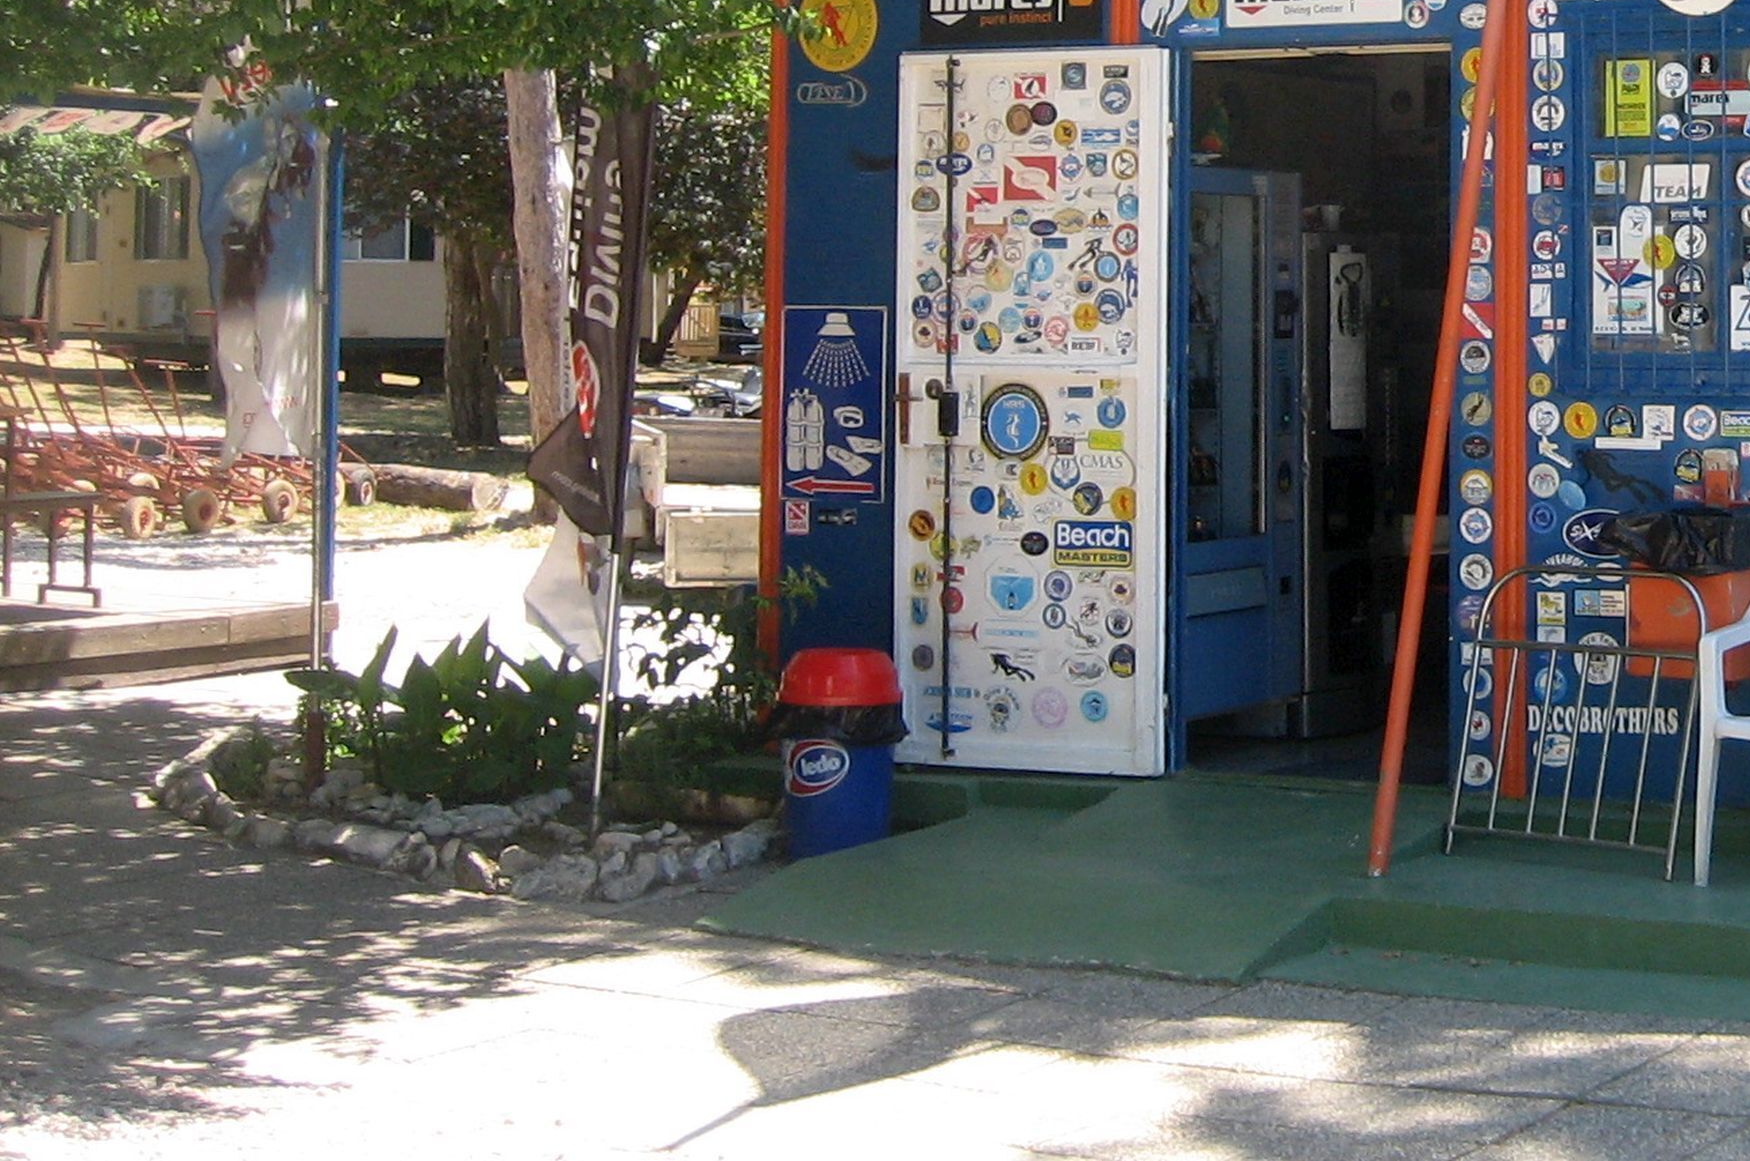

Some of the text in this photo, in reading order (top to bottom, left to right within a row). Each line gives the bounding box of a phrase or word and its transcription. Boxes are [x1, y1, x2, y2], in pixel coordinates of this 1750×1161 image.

[1283, 4, 1343, 16] Diving Center
[1654, 185, 1702, 198] TEAM
[1080, 454, 1124, 470] CMAS
[1056, 523, 1130, 547] Beach
[1527, 704, 1679, 735] DCOBROTHRS
[800, 754, 840, 777] ledo
